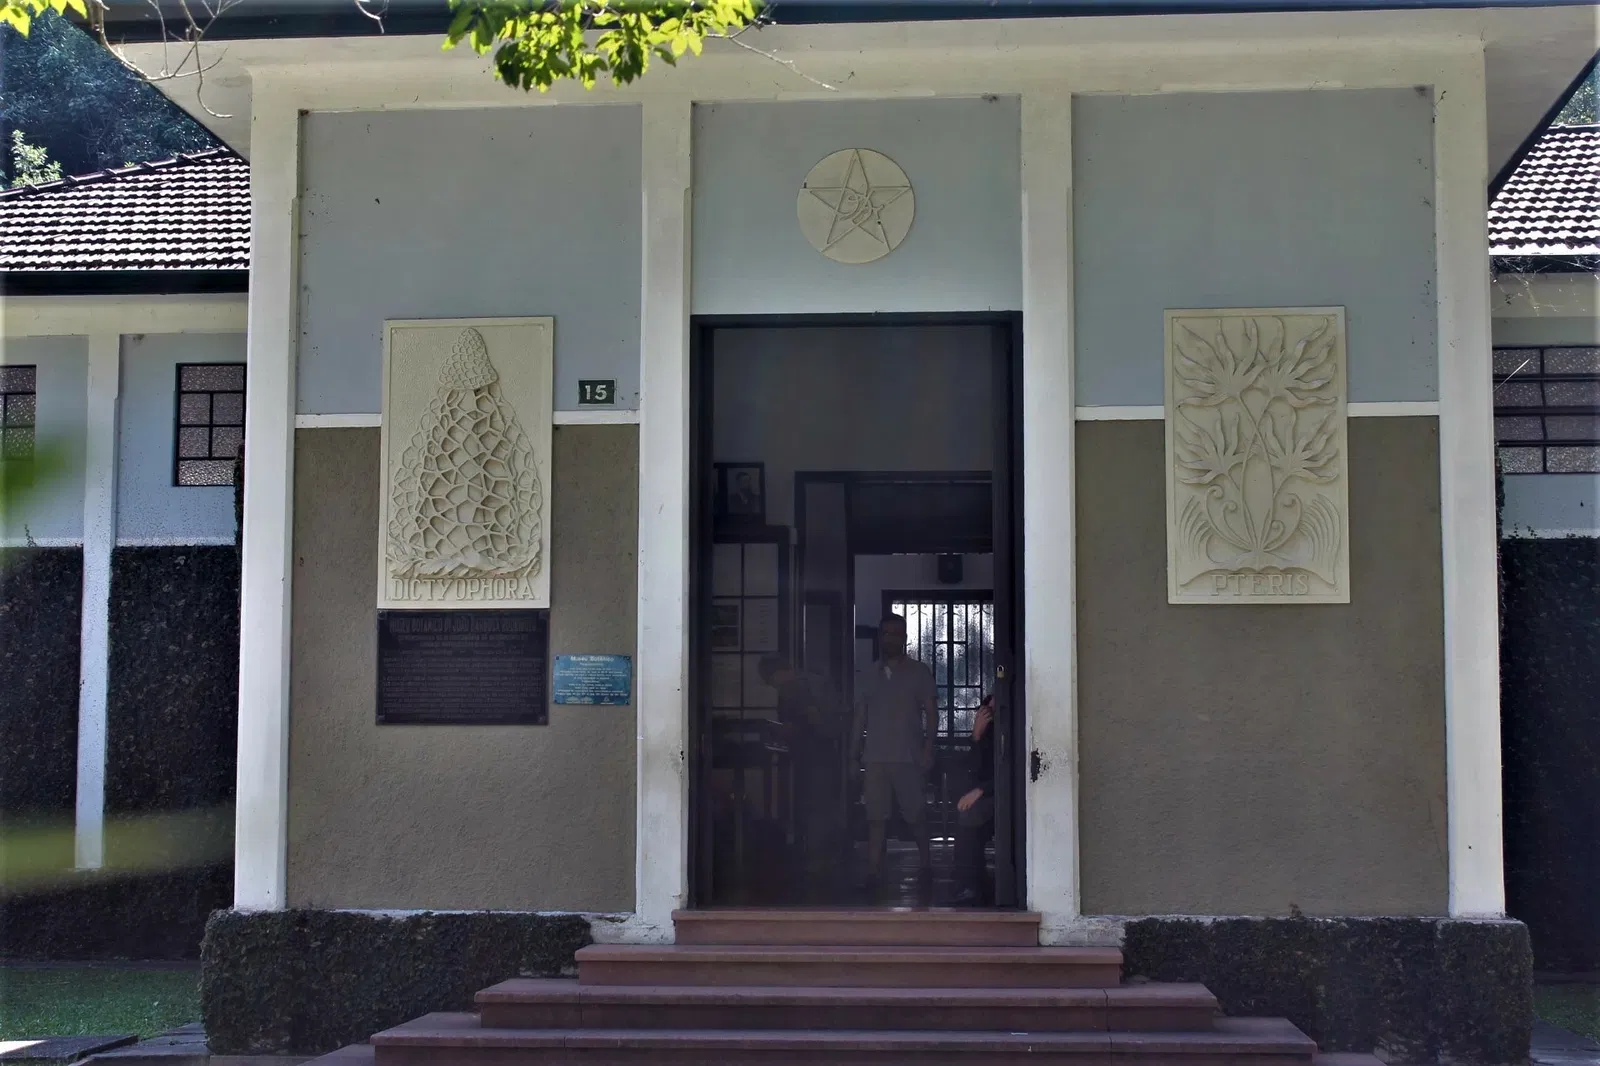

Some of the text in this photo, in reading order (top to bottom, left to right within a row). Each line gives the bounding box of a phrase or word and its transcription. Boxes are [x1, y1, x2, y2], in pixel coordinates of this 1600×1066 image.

[585, 385, 607, 400] 15
[392, 576, 536, 601] DICTYOPHORA
[1210, 574, 1309, 596] PTERIS
